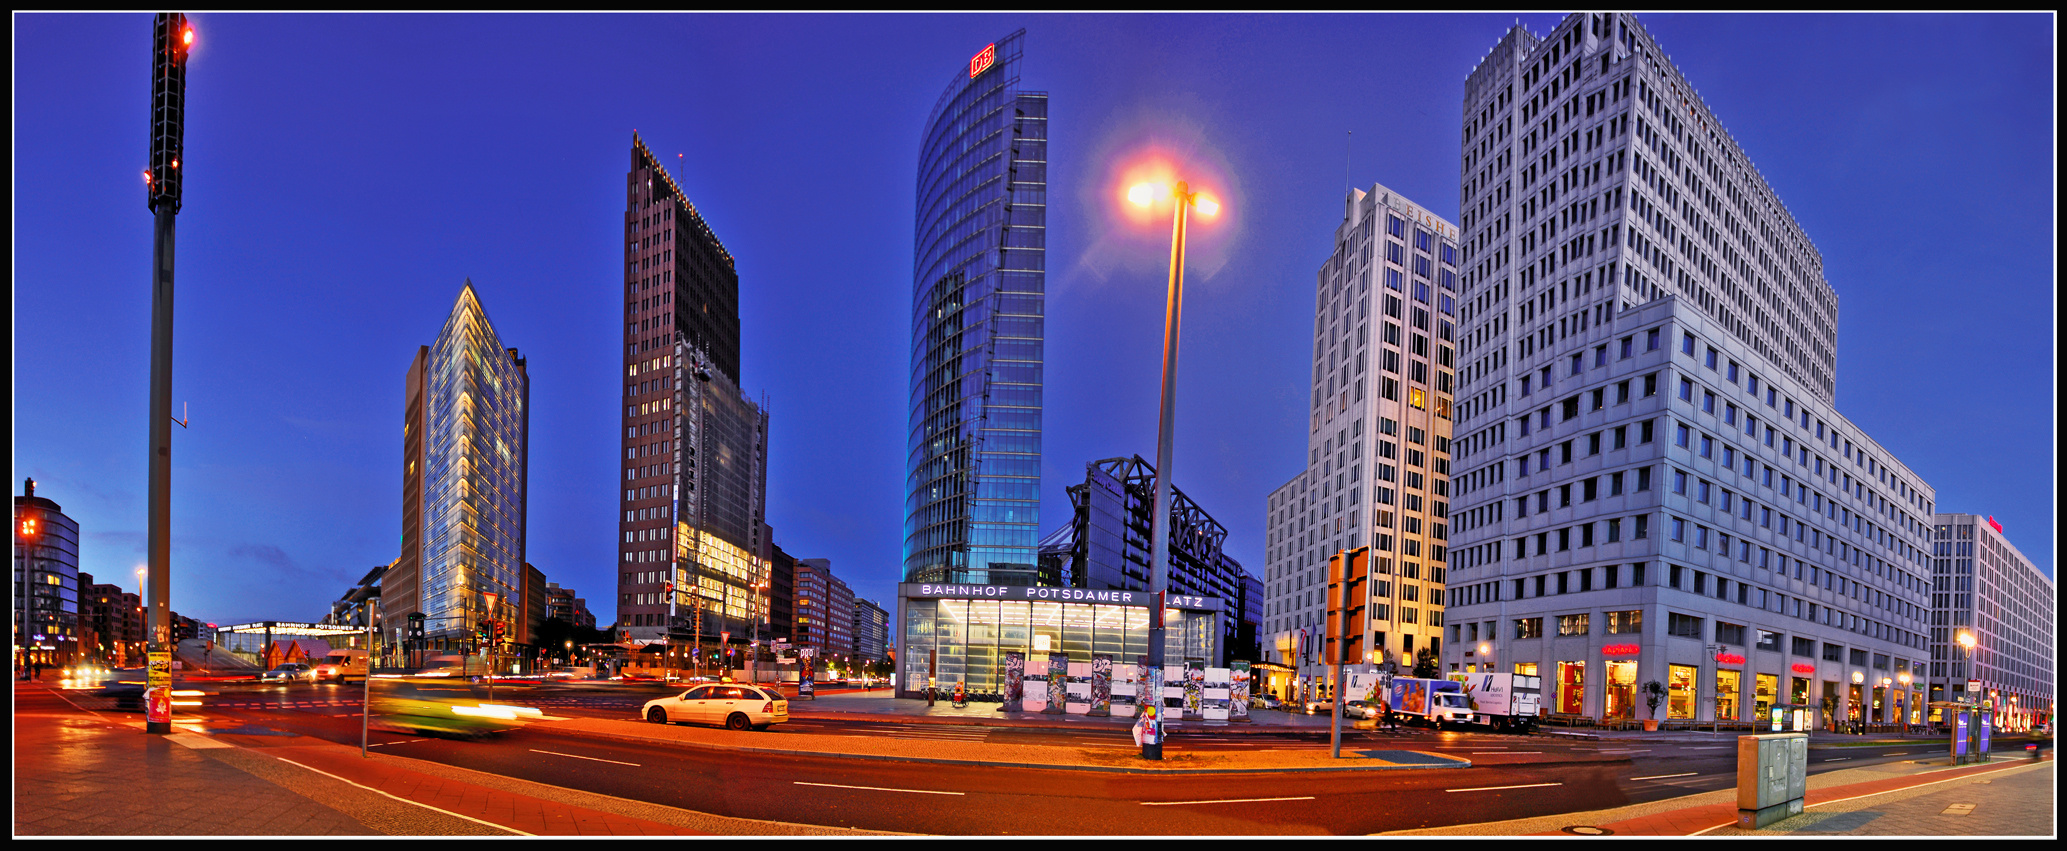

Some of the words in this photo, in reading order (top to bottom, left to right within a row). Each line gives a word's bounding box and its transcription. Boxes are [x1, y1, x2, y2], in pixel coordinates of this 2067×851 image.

[973, 49, 992, 75] DB
[922, 585, 1008, 596] BAHNHOF
[1026, 588, 1132, 602] POTSDAMER
[1166, 596, 1203, 607] ATZ
